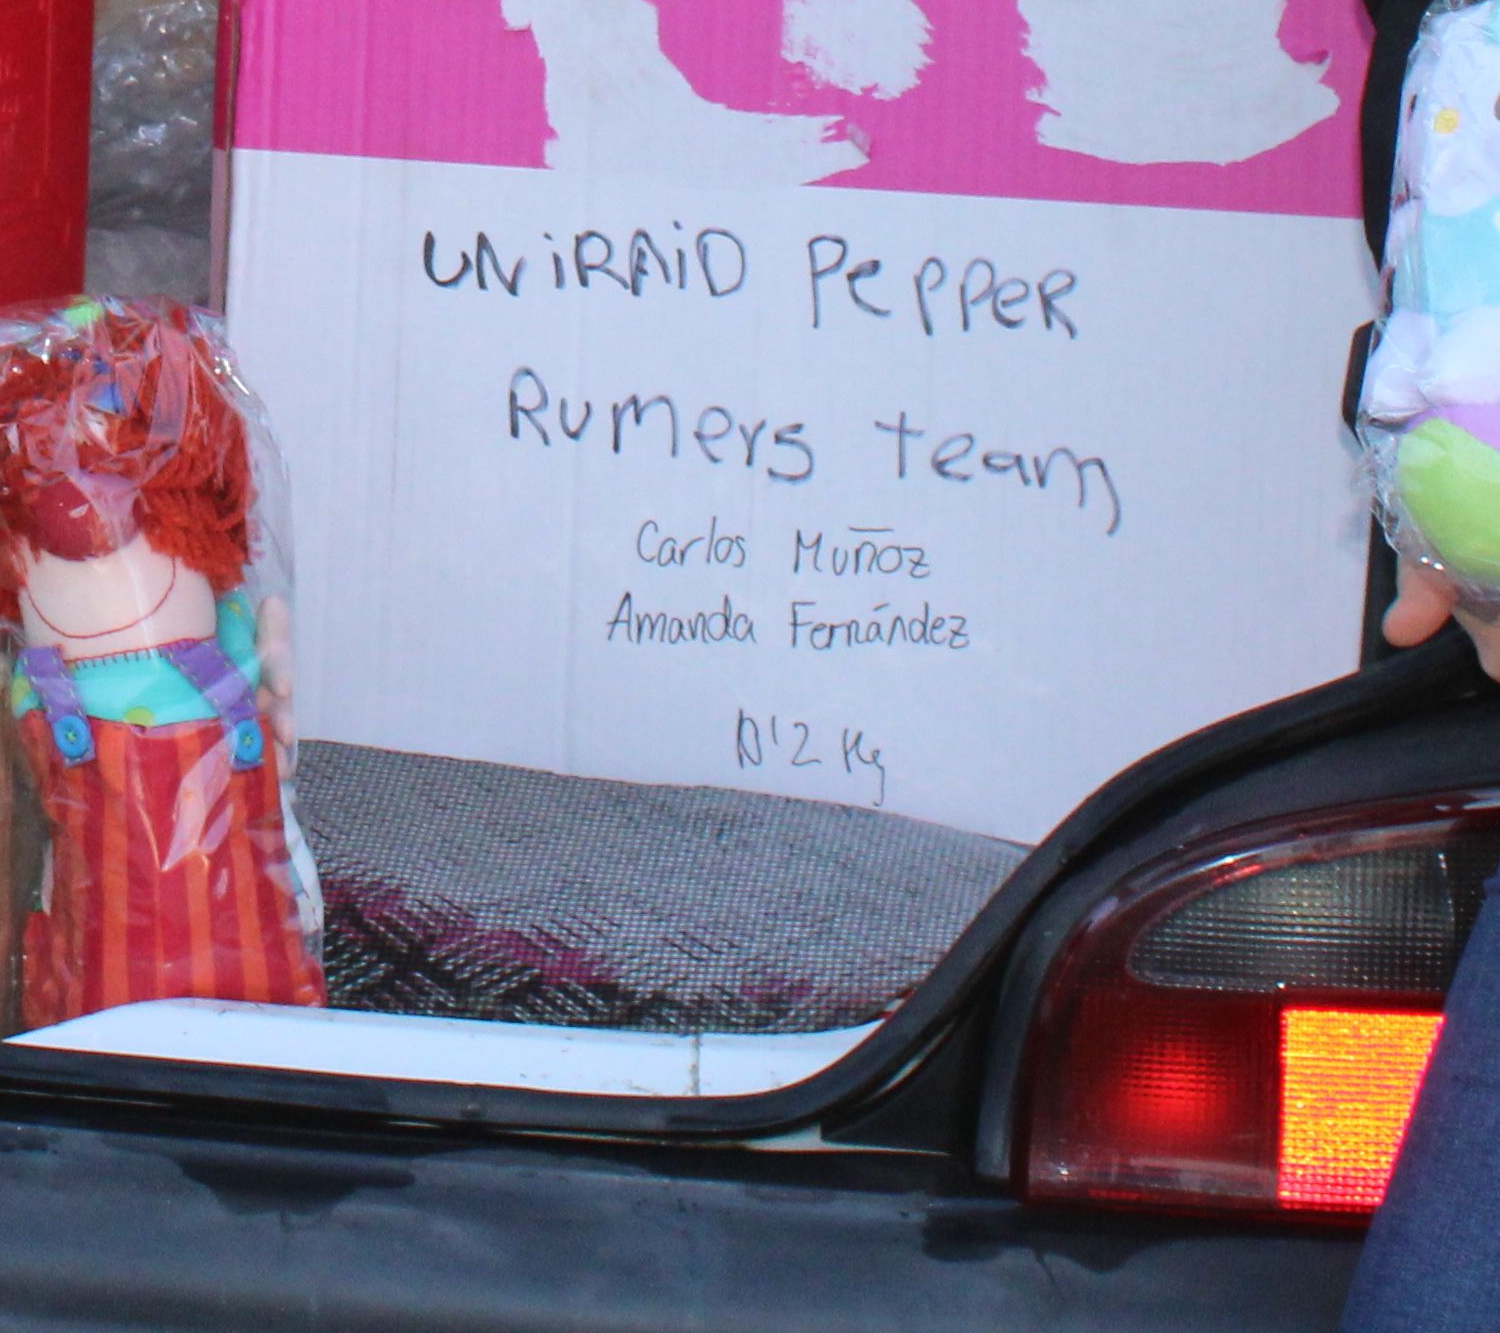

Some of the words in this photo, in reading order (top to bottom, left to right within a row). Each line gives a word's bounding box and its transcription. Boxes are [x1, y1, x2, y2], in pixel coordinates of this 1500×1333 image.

[636, 515, 747, 568] Carlos
[792, 525, 932, 579] Muñoz
[606, 590, 757, 645] Amanda
[788, 600, 970, 651] Fernández
